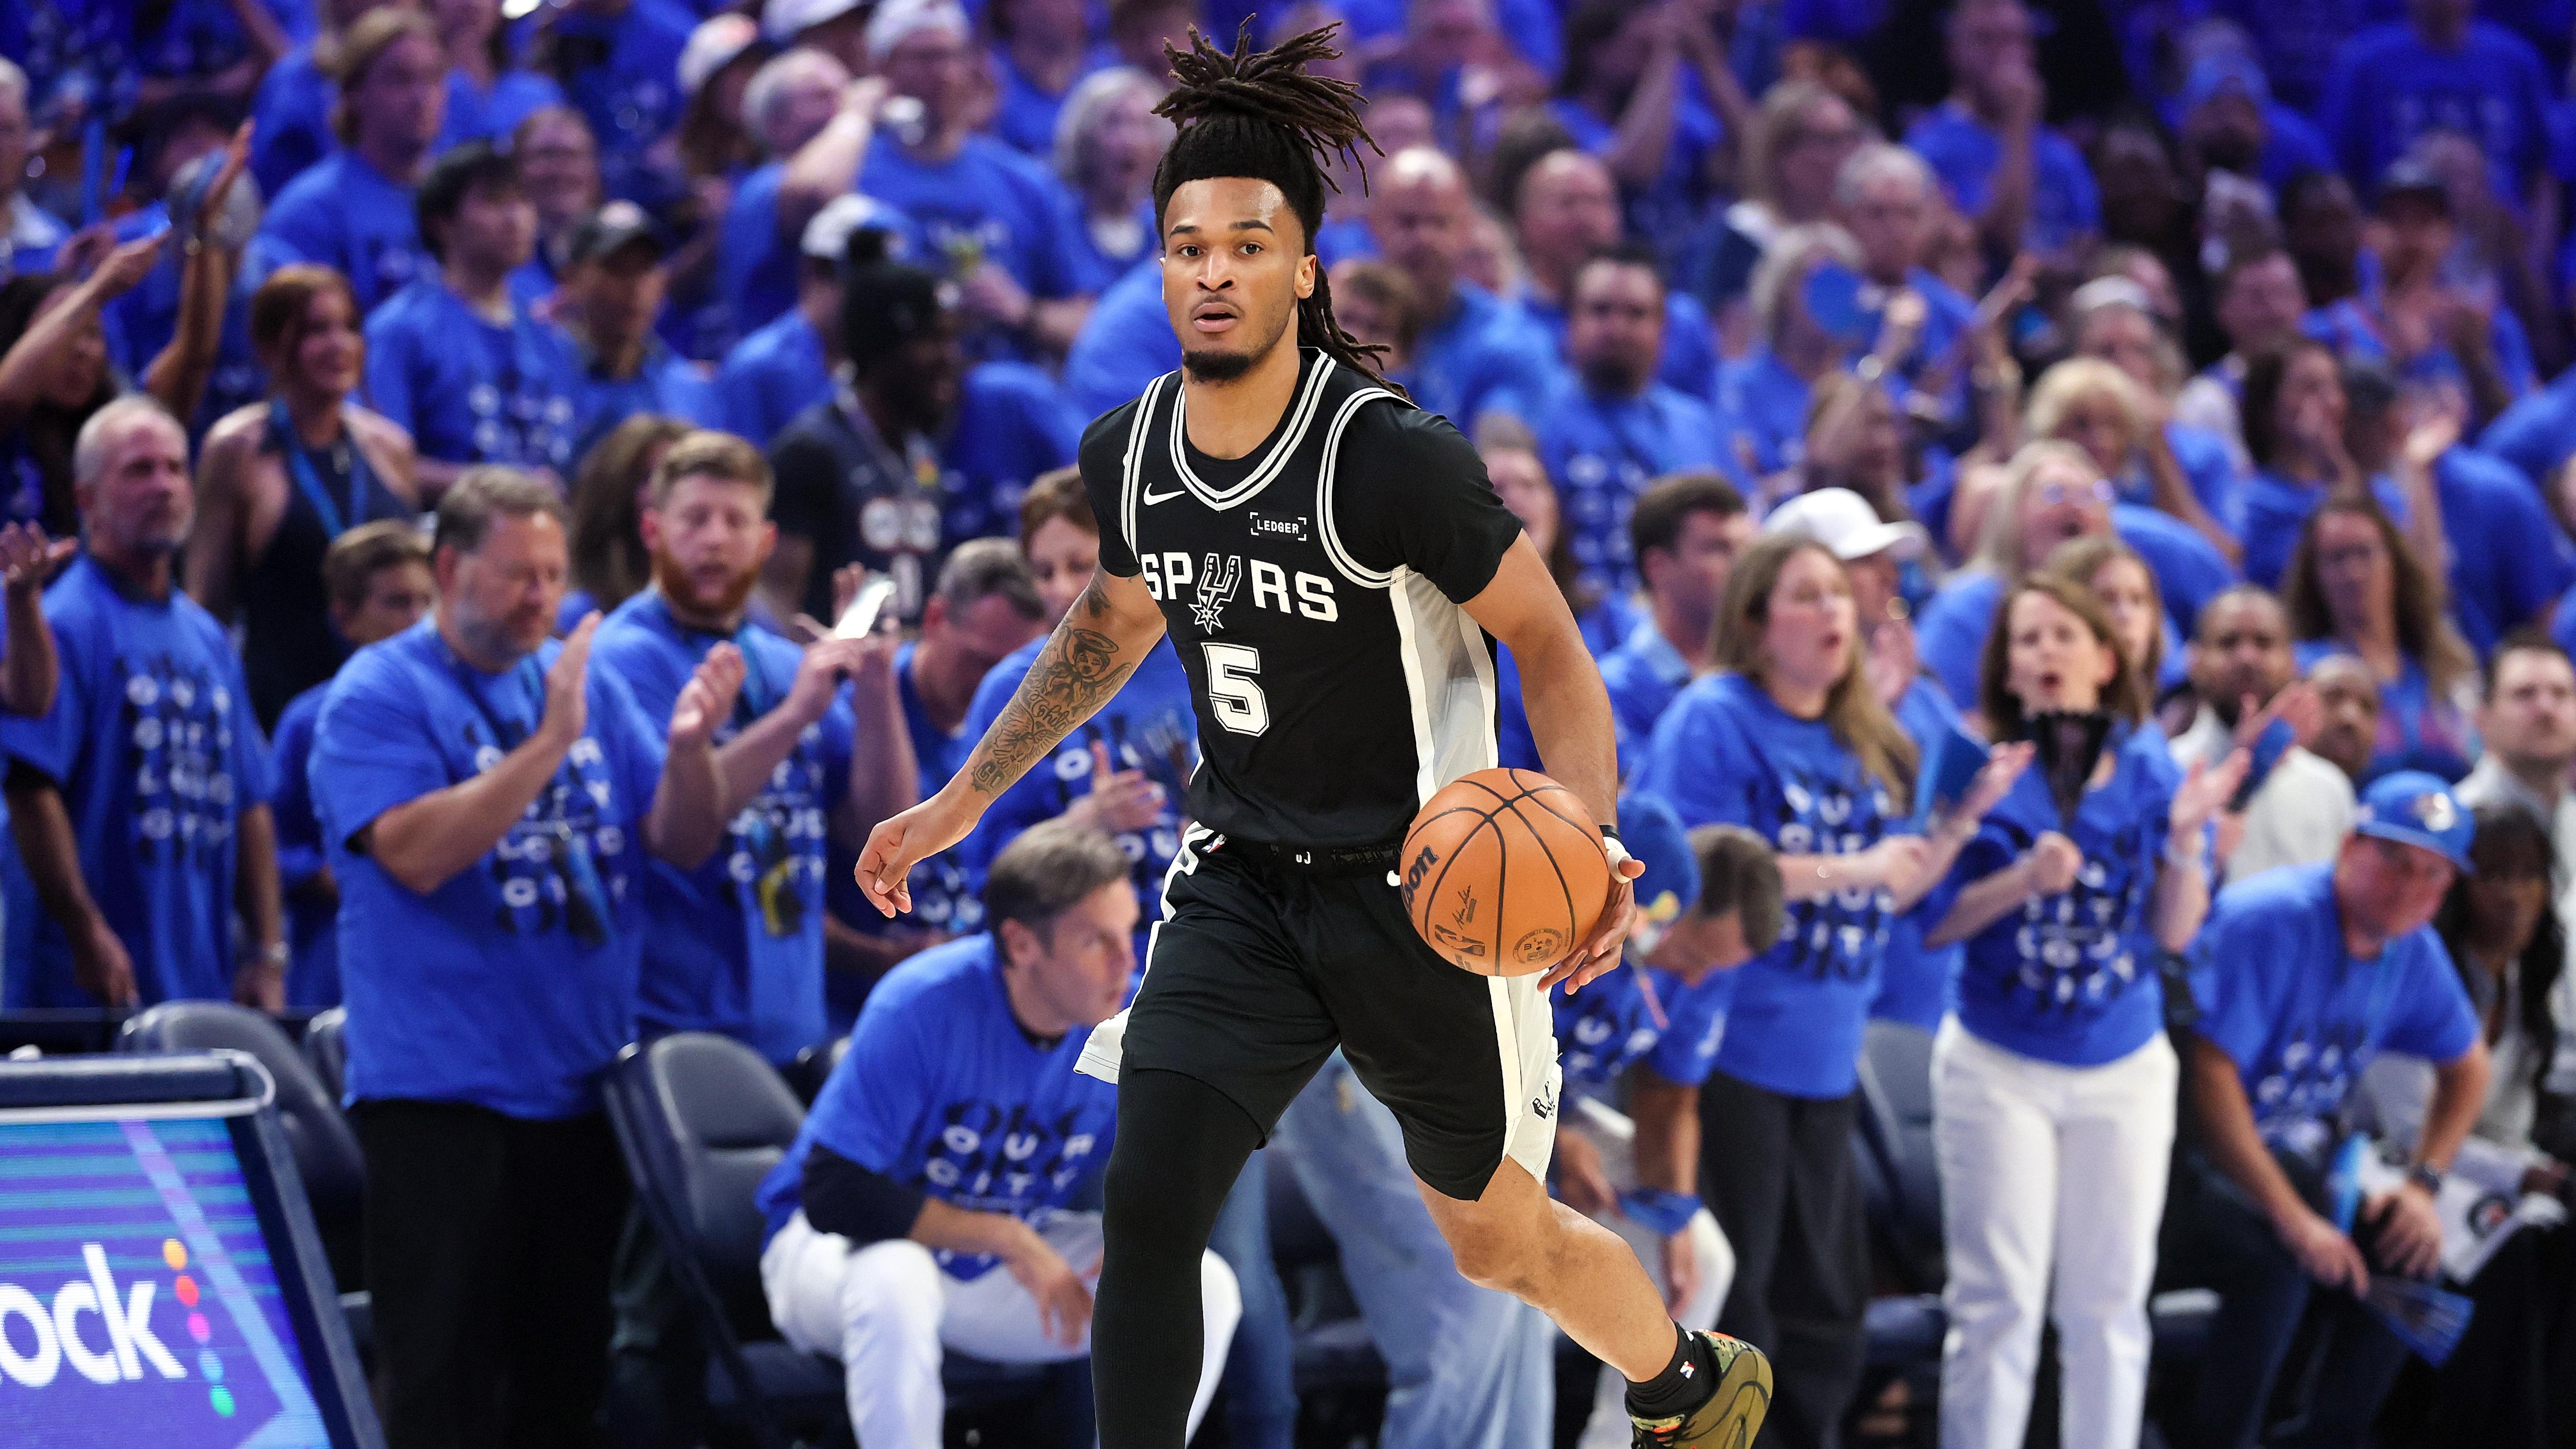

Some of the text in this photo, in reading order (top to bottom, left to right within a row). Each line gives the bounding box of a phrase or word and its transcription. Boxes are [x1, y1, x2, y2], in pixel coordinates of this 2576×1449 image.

[1257, 519, 1299, 534] LEDGER
[1200, 642, 1269, 738] 5
[943, 1124, 1096, 1162] OUR
